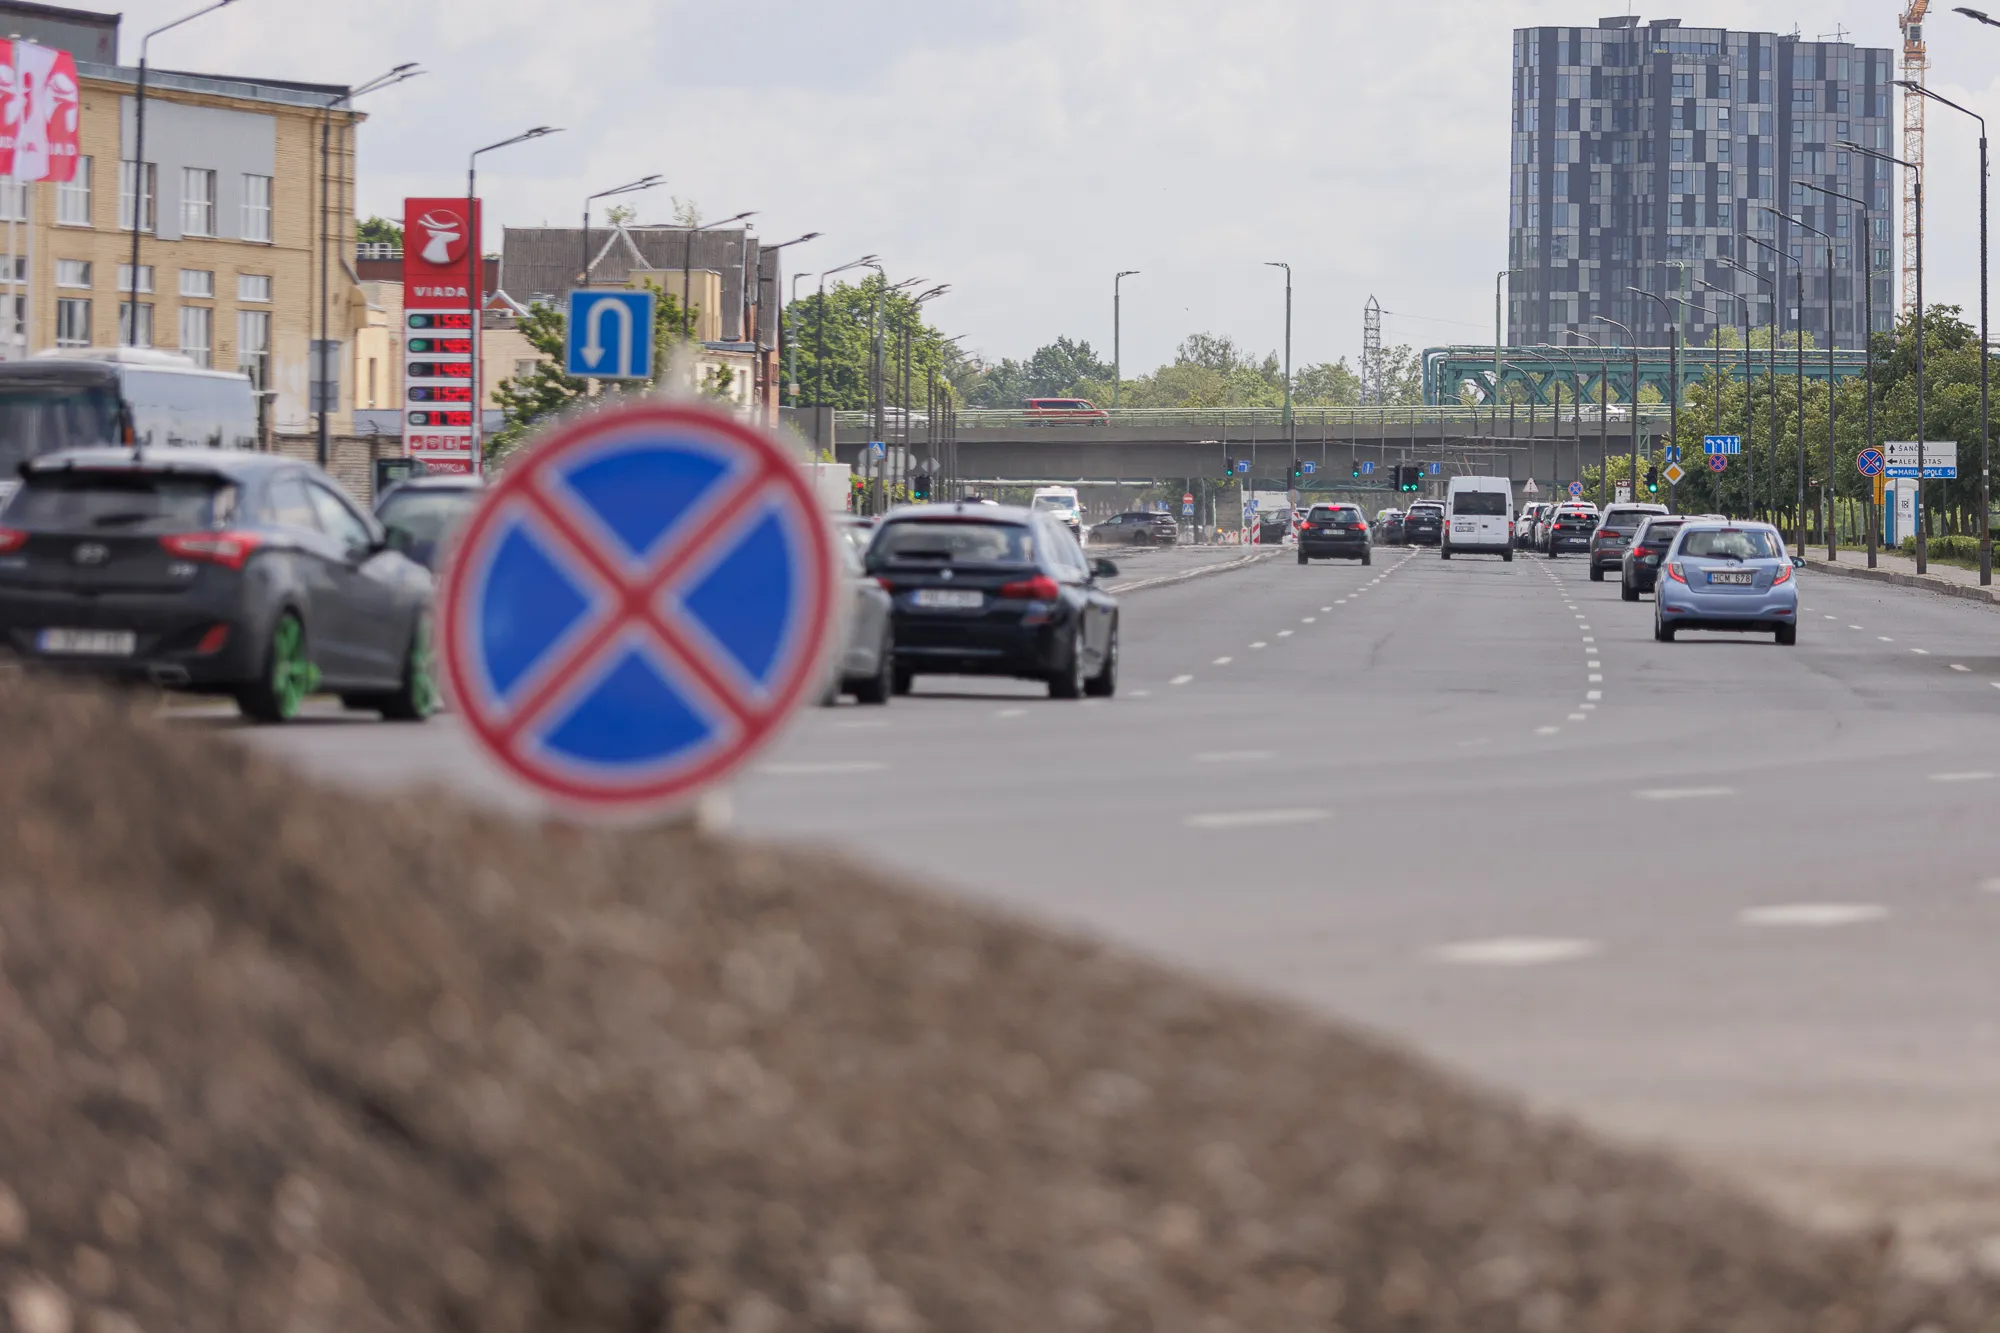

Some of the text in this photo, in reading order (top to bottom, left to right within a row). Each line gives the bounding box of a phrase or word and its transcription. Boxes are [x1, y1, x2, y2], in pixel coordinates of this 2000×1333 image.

[413, 286, 468, 297] VIADA
[1898, 444, 1929, 452] ŠANČAI
[1898, 468, 1942, 476] MARIJMPOLĖ
[1713, 574, 1751, 583] HCM 678
